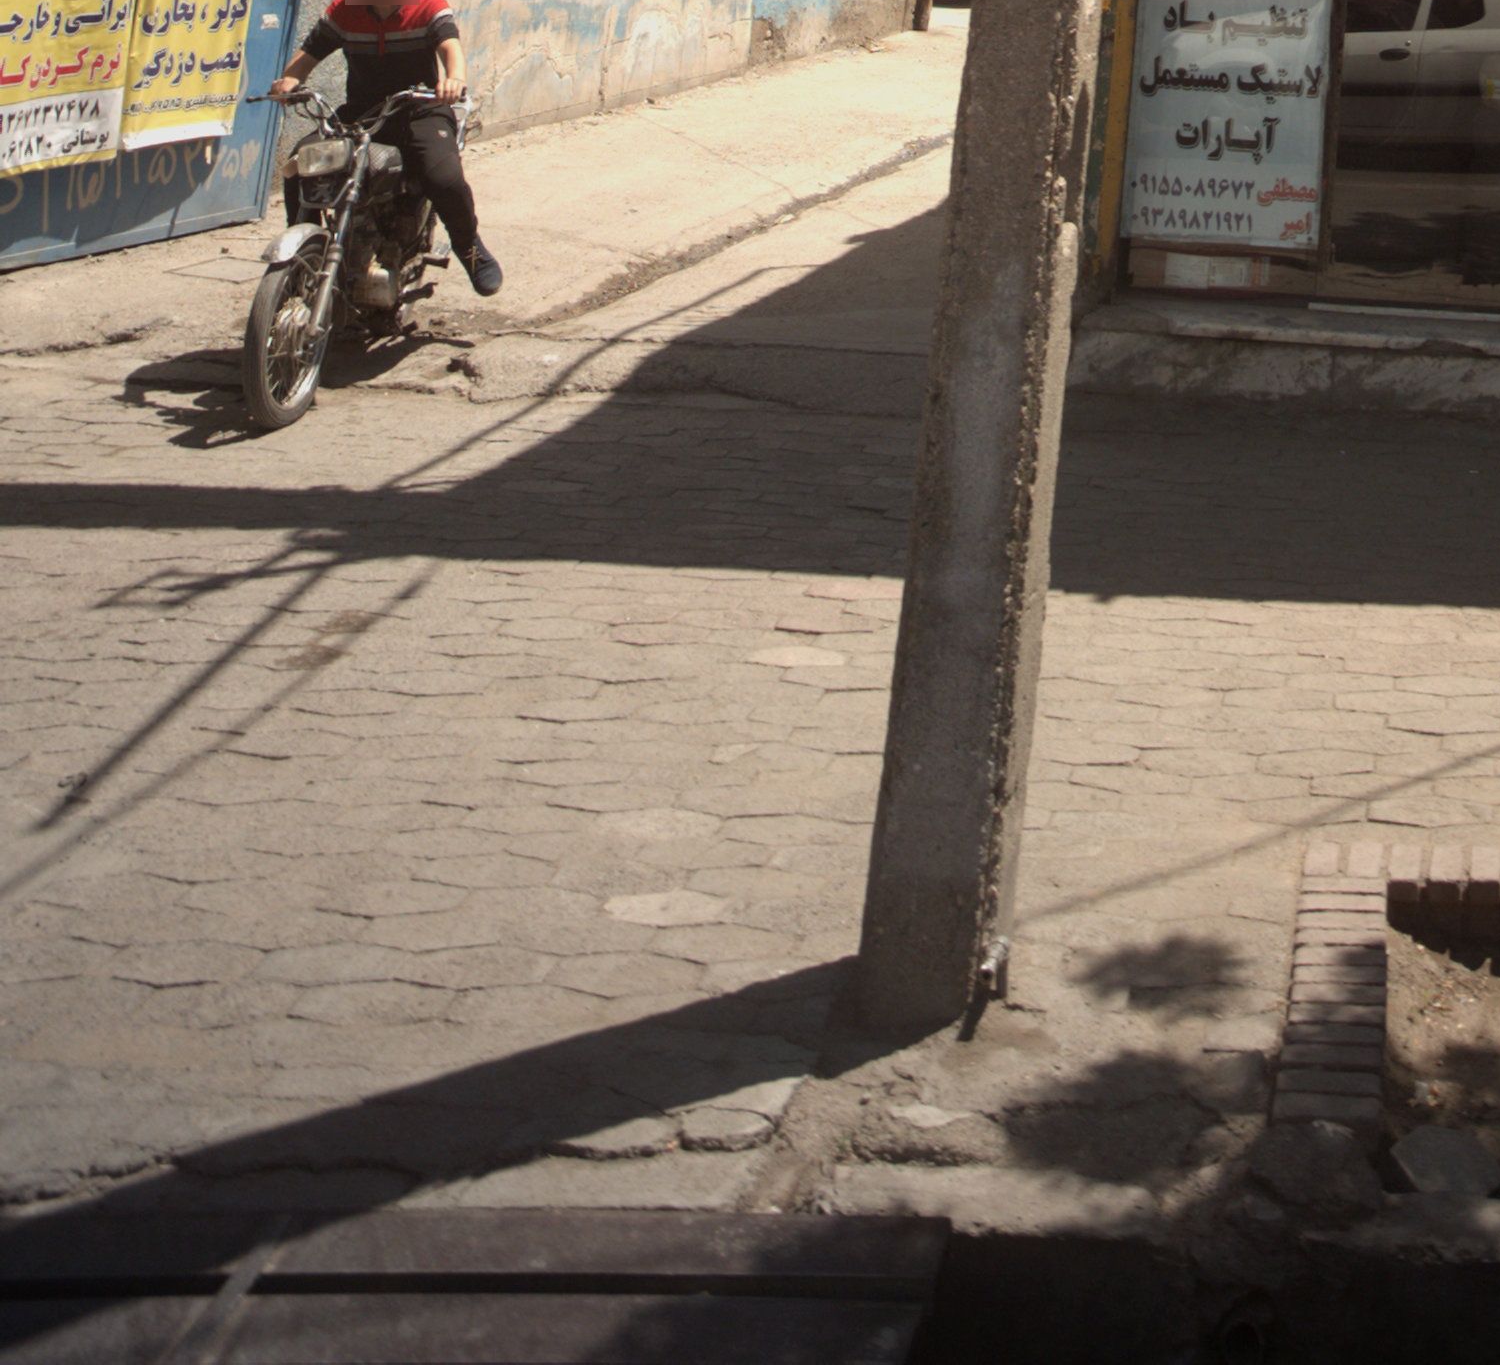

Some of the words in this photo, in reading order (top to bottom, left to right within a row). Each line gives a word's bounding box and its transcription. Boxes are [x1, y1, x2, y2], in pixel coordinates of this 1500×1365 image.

[1163, 0, 1217, 44] باد
[132, 47, 196, 91] دزدگیر
[200, 40, 243, 82] نصب
[1139, 54, 1231, 97] مستعمل
[1236, 63, 1323, 105] لاستیک
[1174, 116, 1281, 166] آپارات
[1256, 177, 1320, 207] مصطفی
